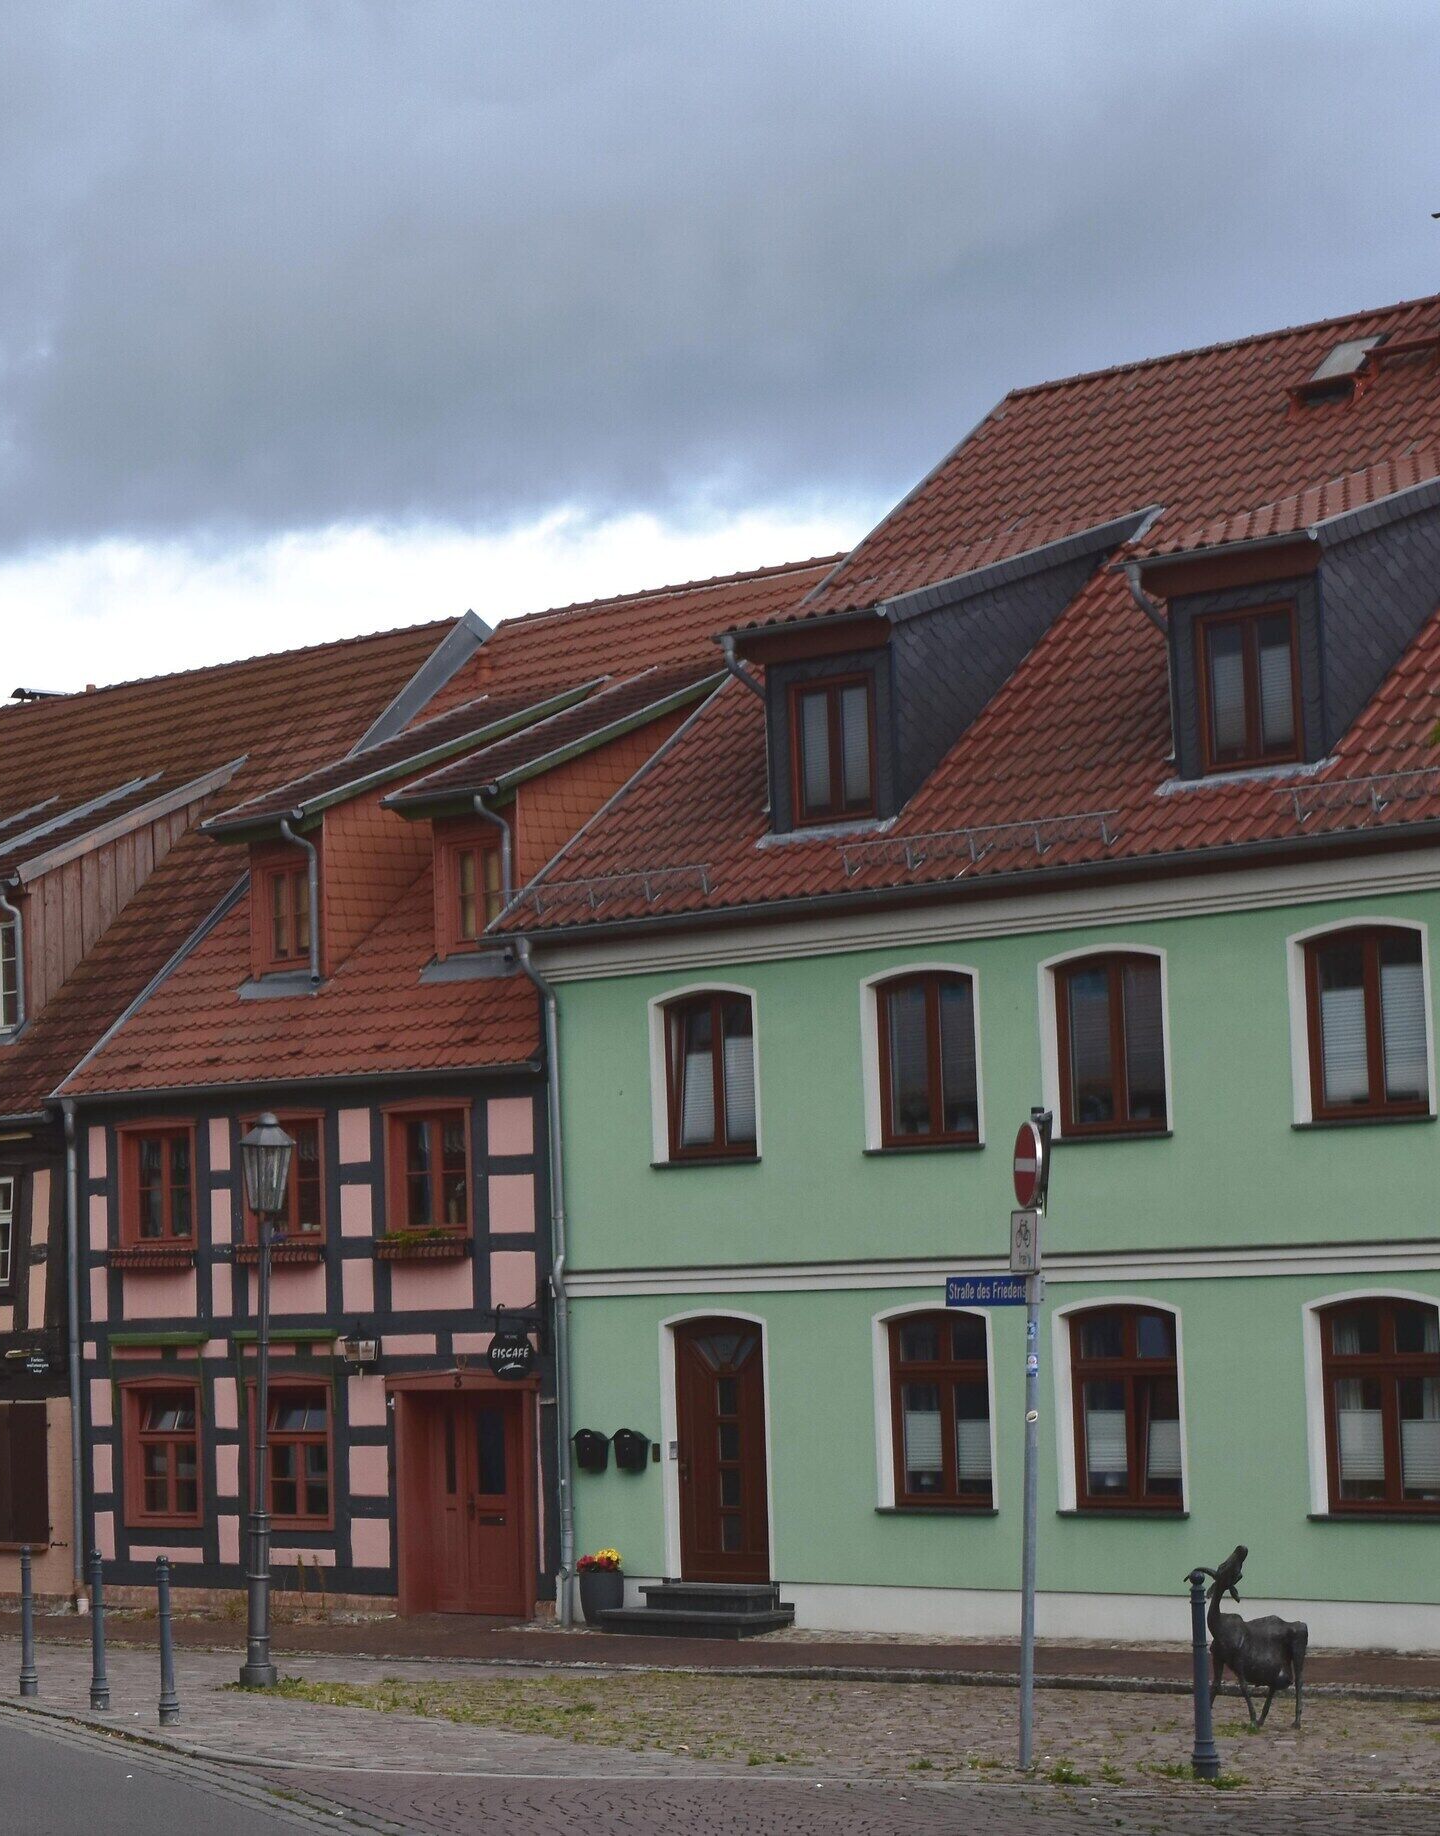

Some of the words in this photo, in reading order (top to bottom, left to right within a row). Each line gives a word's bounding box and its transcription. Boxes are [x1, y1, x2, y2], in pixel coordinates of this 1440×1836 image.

[949, 1282, 975, 1300] Straße
[976, 1282, 991, 1299] des
[993, 1282, 1027, 1299] Friedens
[491, 1343, 530, 1359] EISCAFÉ
